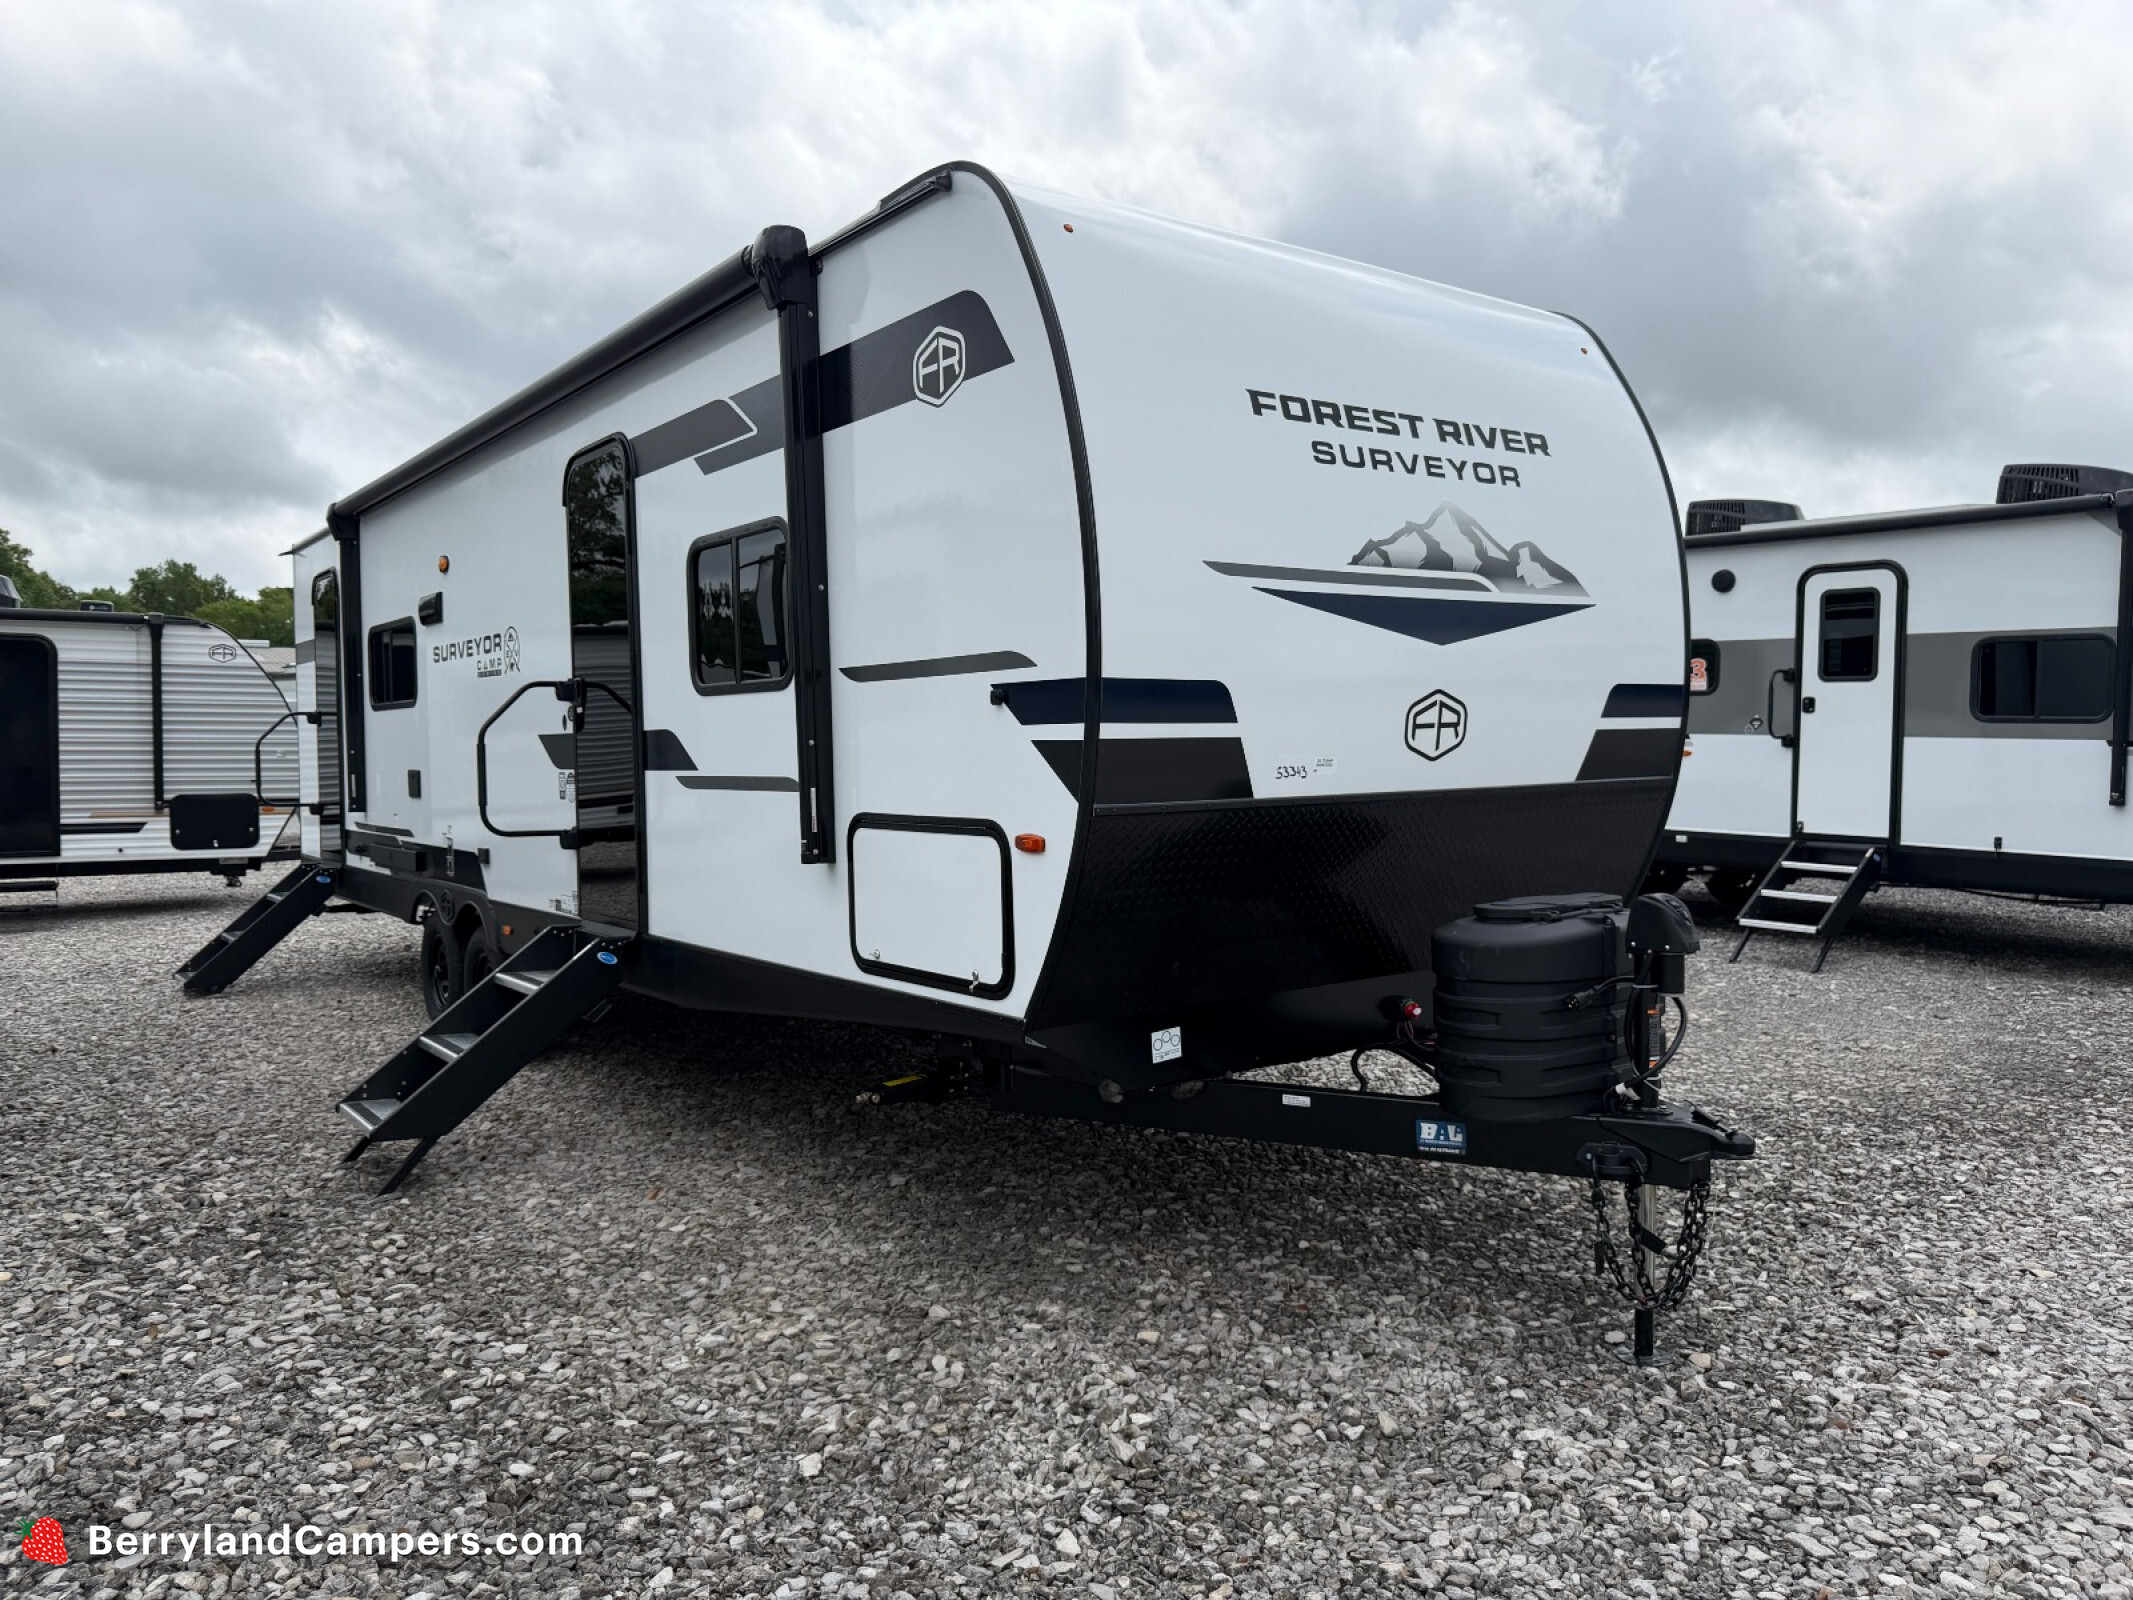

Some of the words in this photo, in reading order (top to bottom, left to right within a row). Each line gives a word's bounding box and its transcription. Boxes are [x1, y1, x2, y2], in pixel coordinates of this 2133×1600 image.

[1246, 389, 1424, 439] FOREST
[1432, 418, 1551, 457] RIVER
[1311, 440, 1521, 488] SURVEYOR
[433, 633, 502, 663] SURVEYOR
[477, 658, 502, 671] CAMP
